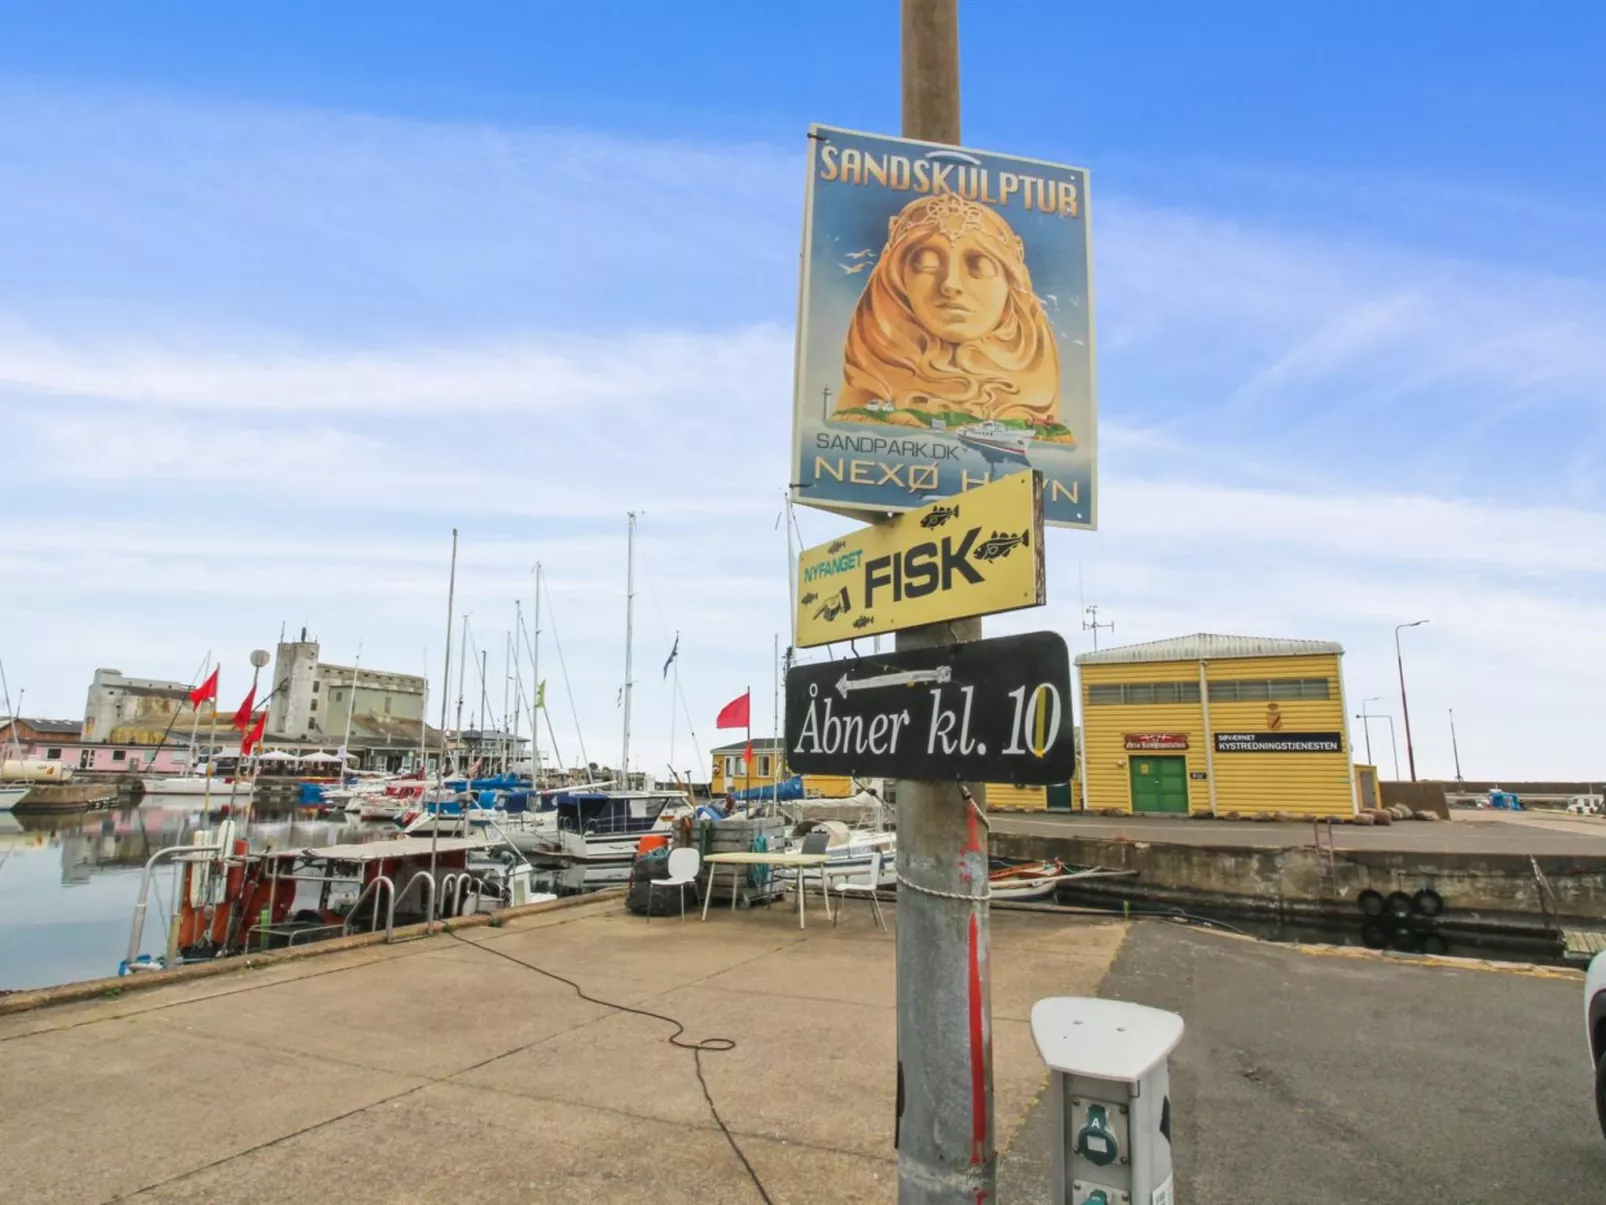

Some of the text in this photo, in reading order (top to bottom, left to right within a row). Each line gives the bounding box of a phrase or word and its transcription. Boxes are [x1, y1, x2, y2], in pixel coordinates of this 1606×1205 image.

[820, 145, 1079, 217] SANDSKULPTUR
[816, 433, 960, 462] SANDPARK.DK
[814, 456, 1079, 504] NEXØ HN
[804, 549, 863, 584] NYFANGET
[864, 526, 985, 609] FISK
[794, 682, 1062, 756] Åbner kl. 10
